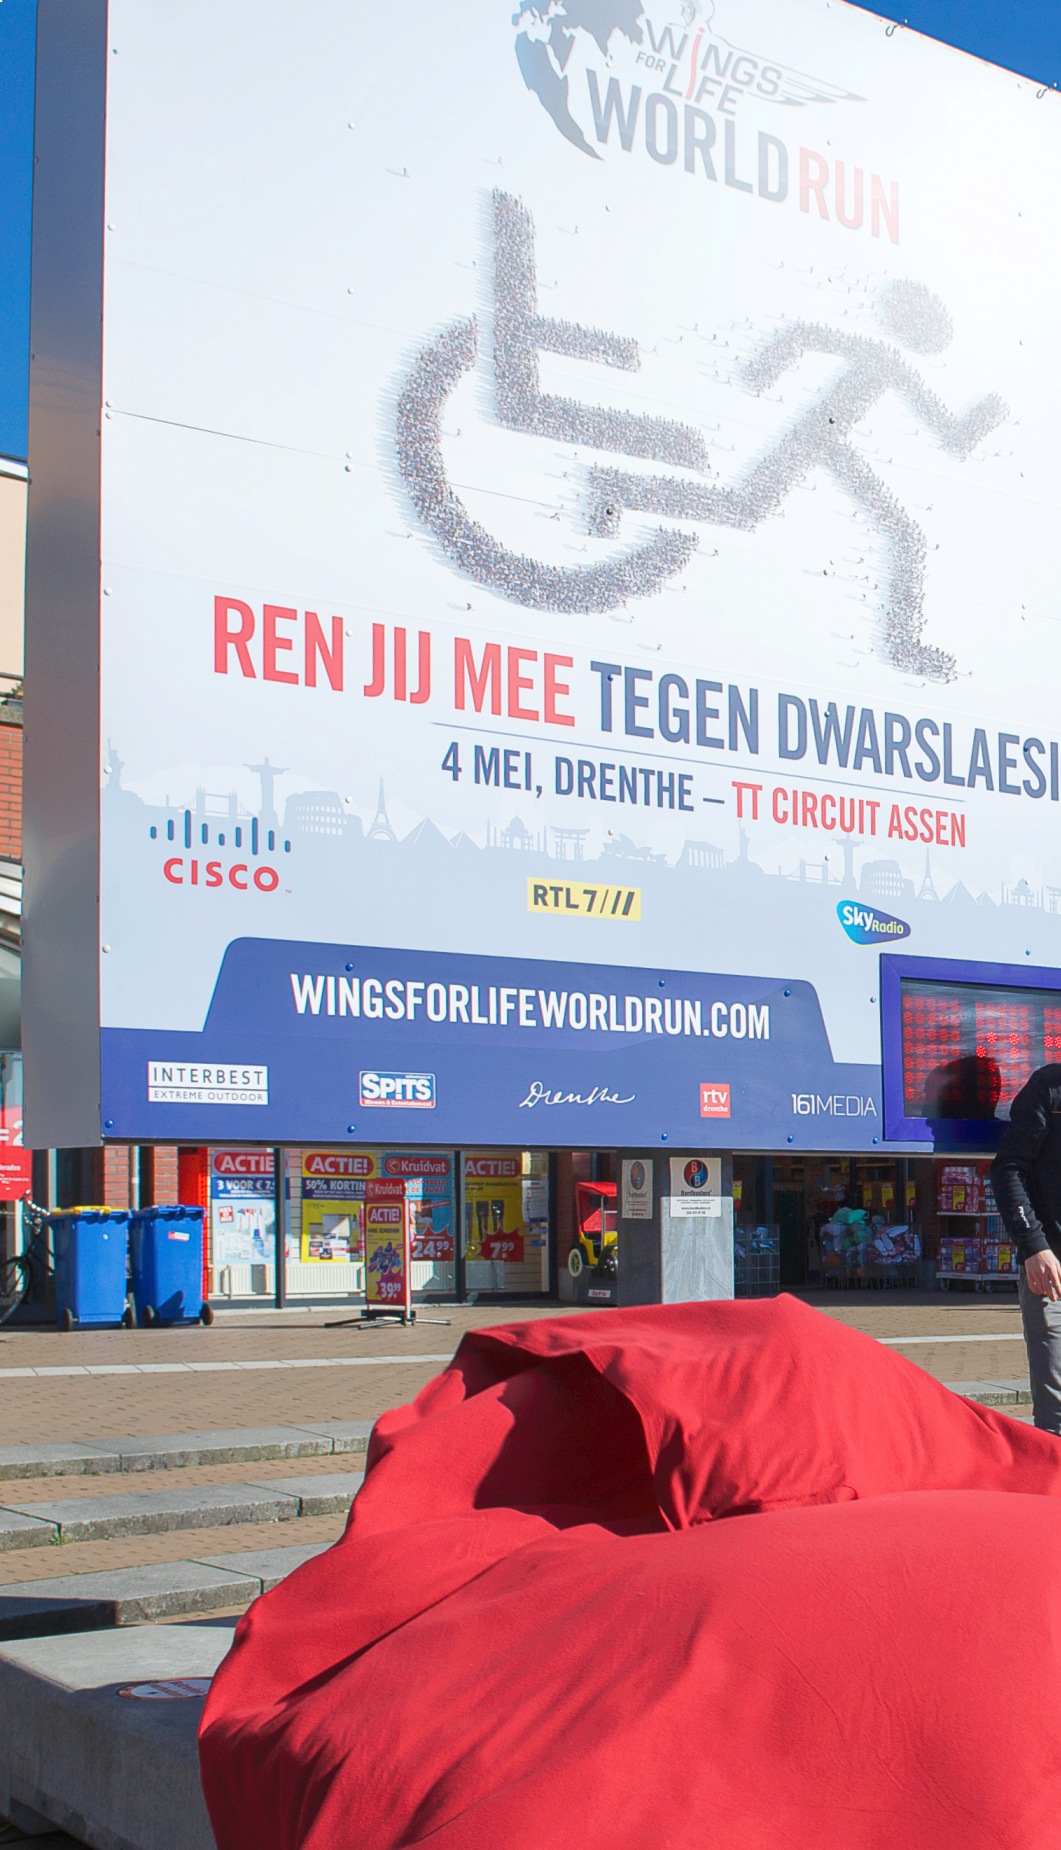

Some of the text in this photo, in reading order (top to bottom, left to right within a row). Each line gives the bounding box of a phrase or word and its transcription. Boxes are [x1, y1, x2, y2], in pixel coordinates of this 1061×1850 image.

[635, 51, 667, 74] FOR
[585, 68, 900, 246] WORLD RUN
[213, 595, 344, 692] REN
[363, 622, 431, 704] JIJ
[454, 637, 576, 727] MEE
[591, 660, 759, 755] TEGEN
[441, 741, 462, 781] 4
[474, 745, 543, 798] MEI,
[555, 756, 695, 812] DRENTHE
[732, 781, 763, 820] TT
[772, 787, 881, 836] CIRCUIT
[888, 804, 966, 848] ASSEN
[163, 857, 280, 893] CISCO
[842, 905, 904, 935] Sky Radio
[291, 973, 771, 1041] WINGSFORLIFEWORLDRUN.COM
[154, 1067, 264, 1086] INTERBEST
[154, 1090, 264, 1102] EXTREME OUTDOOR
[703, 1089, 728, 1105] rtv
[703, 1105, 729, 1113] drenthe
[220, 1155, 275, 1172] ACTIE
[310, 1156, 368, 1174] ACTIE!
[401, 1160, 447, 1173] Kruidvat
[465, 1160, 516, 1175] ACTIE!
[217, 1180, 225, 1190] 3
[226, 1180, 254, 1190] VOOR
[306, 1179, 366, 1191] 50% KORTIN
[375, 1183, 403, 1196] Kruidvat
[370, 1208, 400, 1221] ACTIE!
